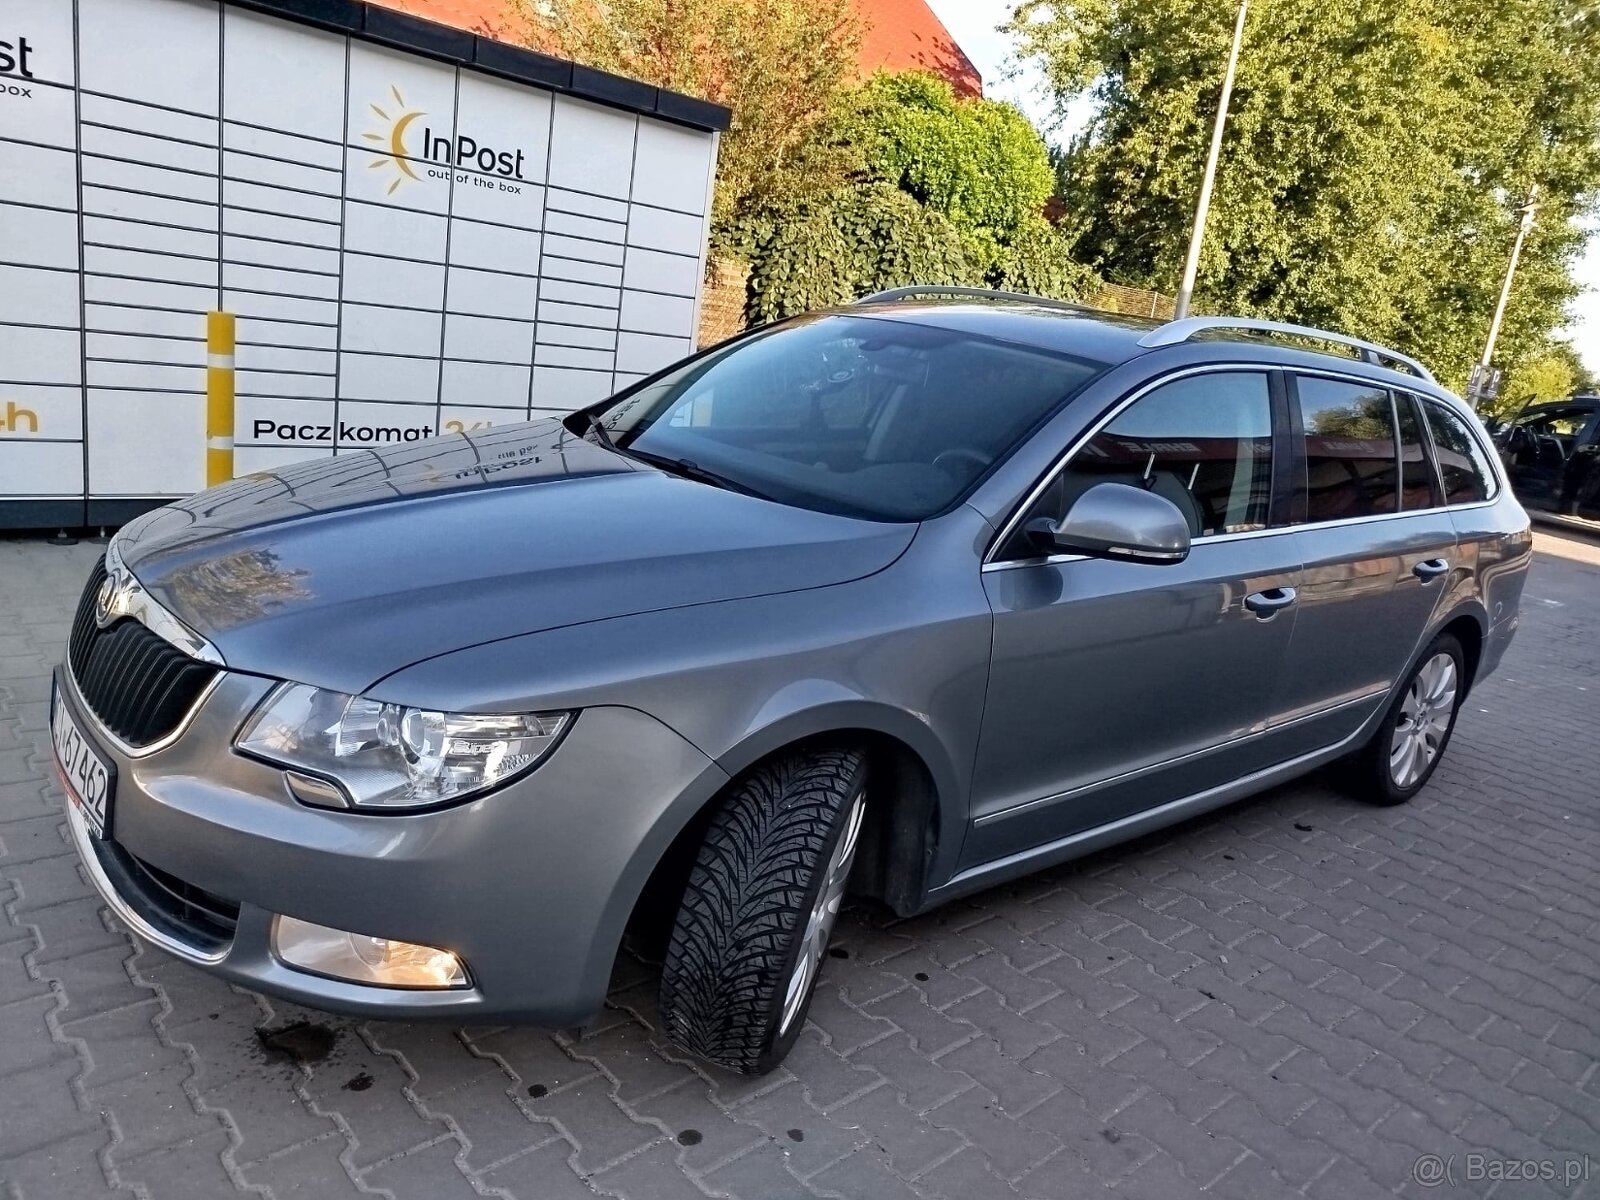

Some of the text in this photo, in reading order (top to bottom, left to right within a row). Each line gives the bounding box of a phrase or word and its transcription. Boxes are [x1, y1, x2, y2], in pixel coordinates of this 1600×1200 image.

[424, 127, 525, 179] InPost
[427, 168, 522, 195] out of the box
[0, 401, 38, 432] h
[253, 419, 433, 442] Paczkomat
[64, 725, 107, 821] 67462
